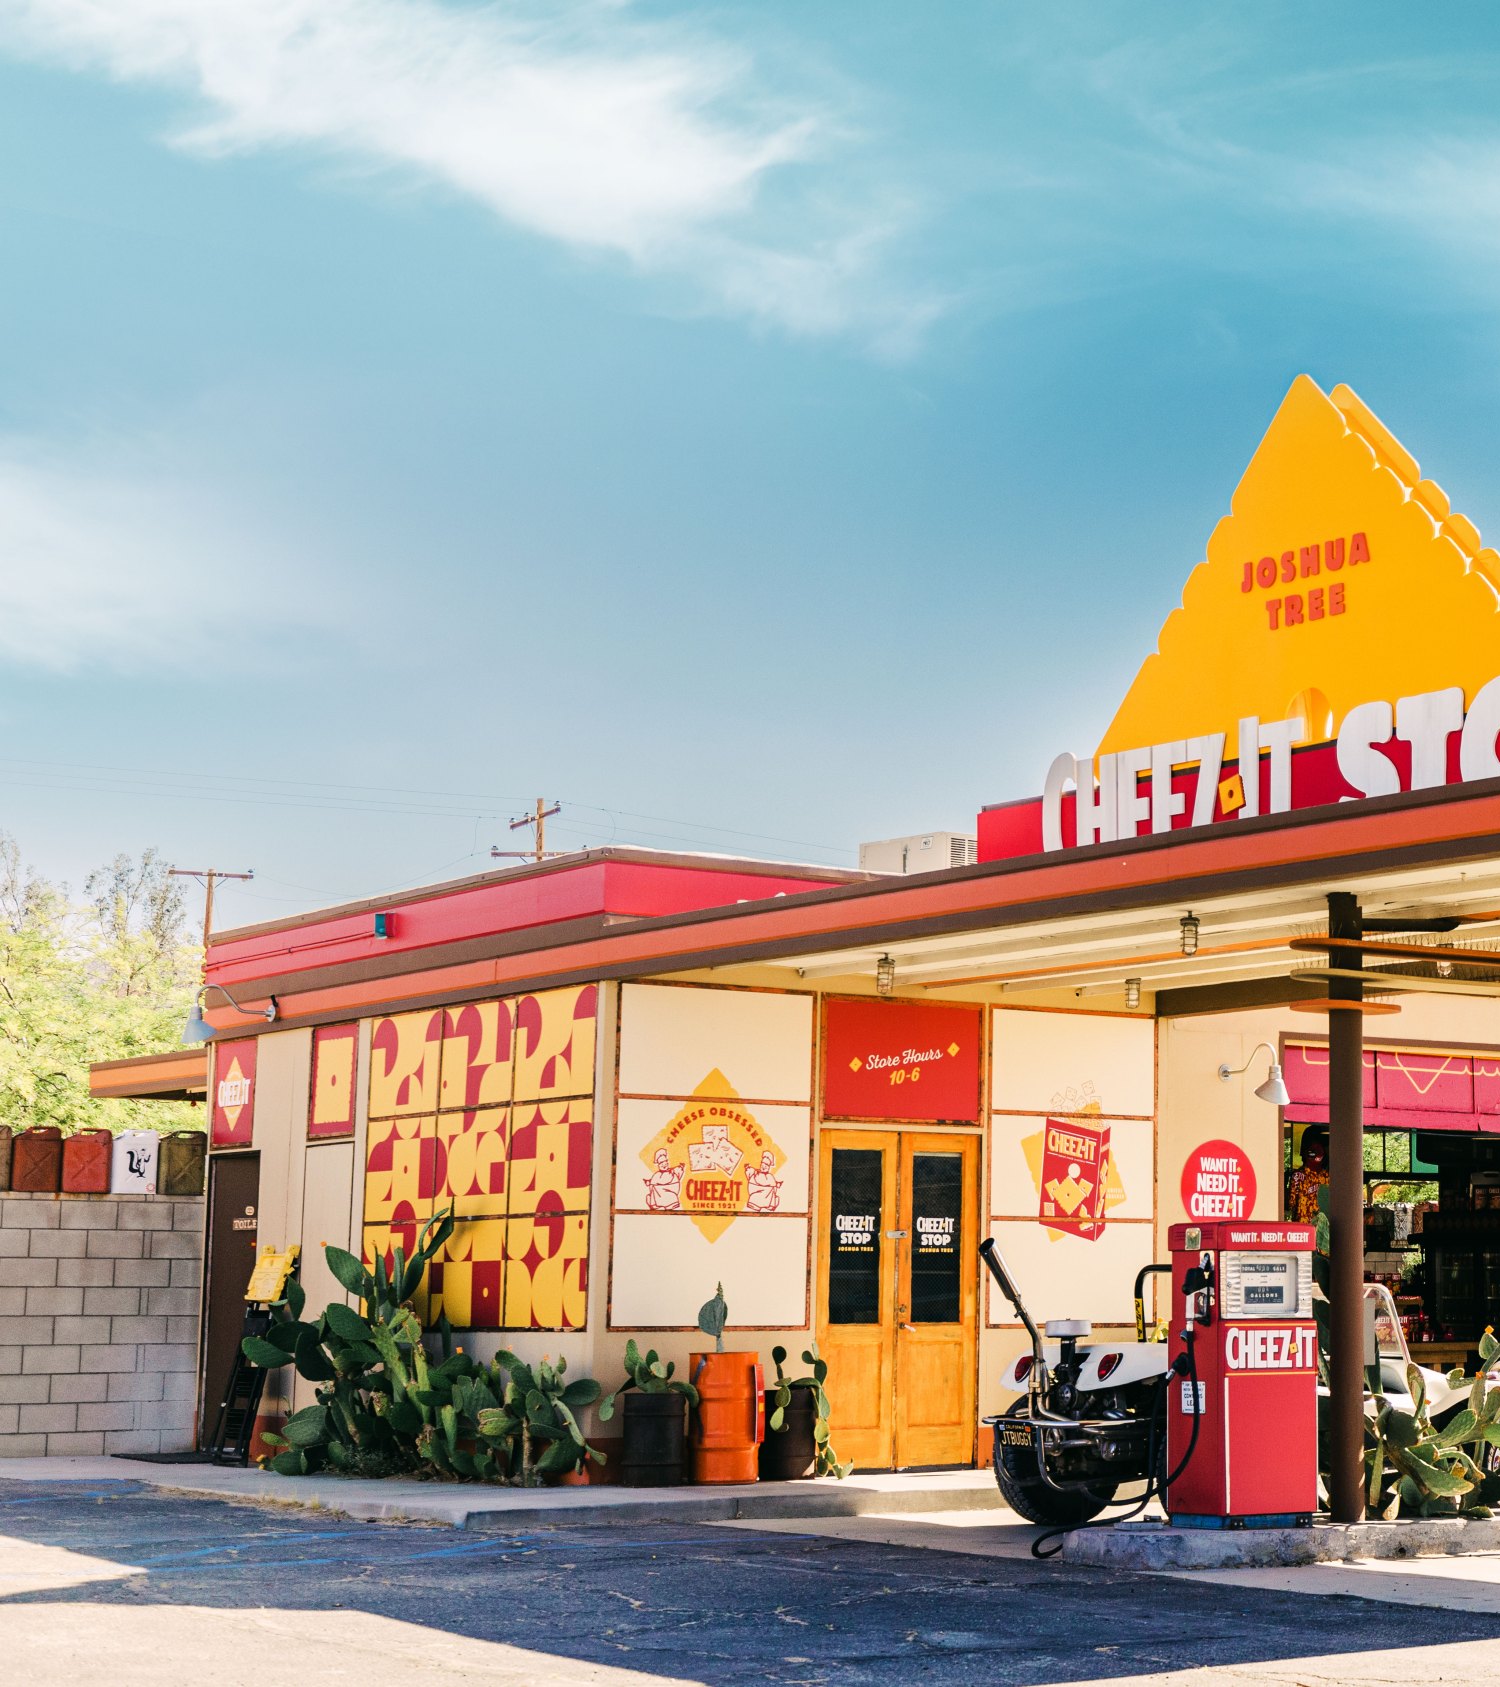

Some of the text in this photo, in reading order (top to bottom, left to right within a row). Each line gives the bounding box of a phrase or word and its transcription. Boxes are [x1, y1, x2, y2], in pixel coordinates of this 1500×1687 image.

[1241, 532, 1371, 593] JOSHUA
[1266, 583, 1346, 630] TREE
[865, 1048, 944, 1070] Store Hours
[889, 1067, 920, 1085] 10-6
[666, 1107, 763, 1147] CHEESE OBSESSED
[1200, 1157, 1228, 1172] WANT
[1196, 1173, 1227, 1192] NEED
[233, 1220, 257, 1229] TOILE
[840, 1232, 871, 1244] STOP
[921, 1234, 951, 1246] STOP
[1231, 1232, 1250, 1242] WANT
[1261, 1232, 1277, 1242] NEED
[1225, 1327, 1317, 1369] CHEEZ-IT
[1001, 1431, 1032, 1446] JTBUGGY
